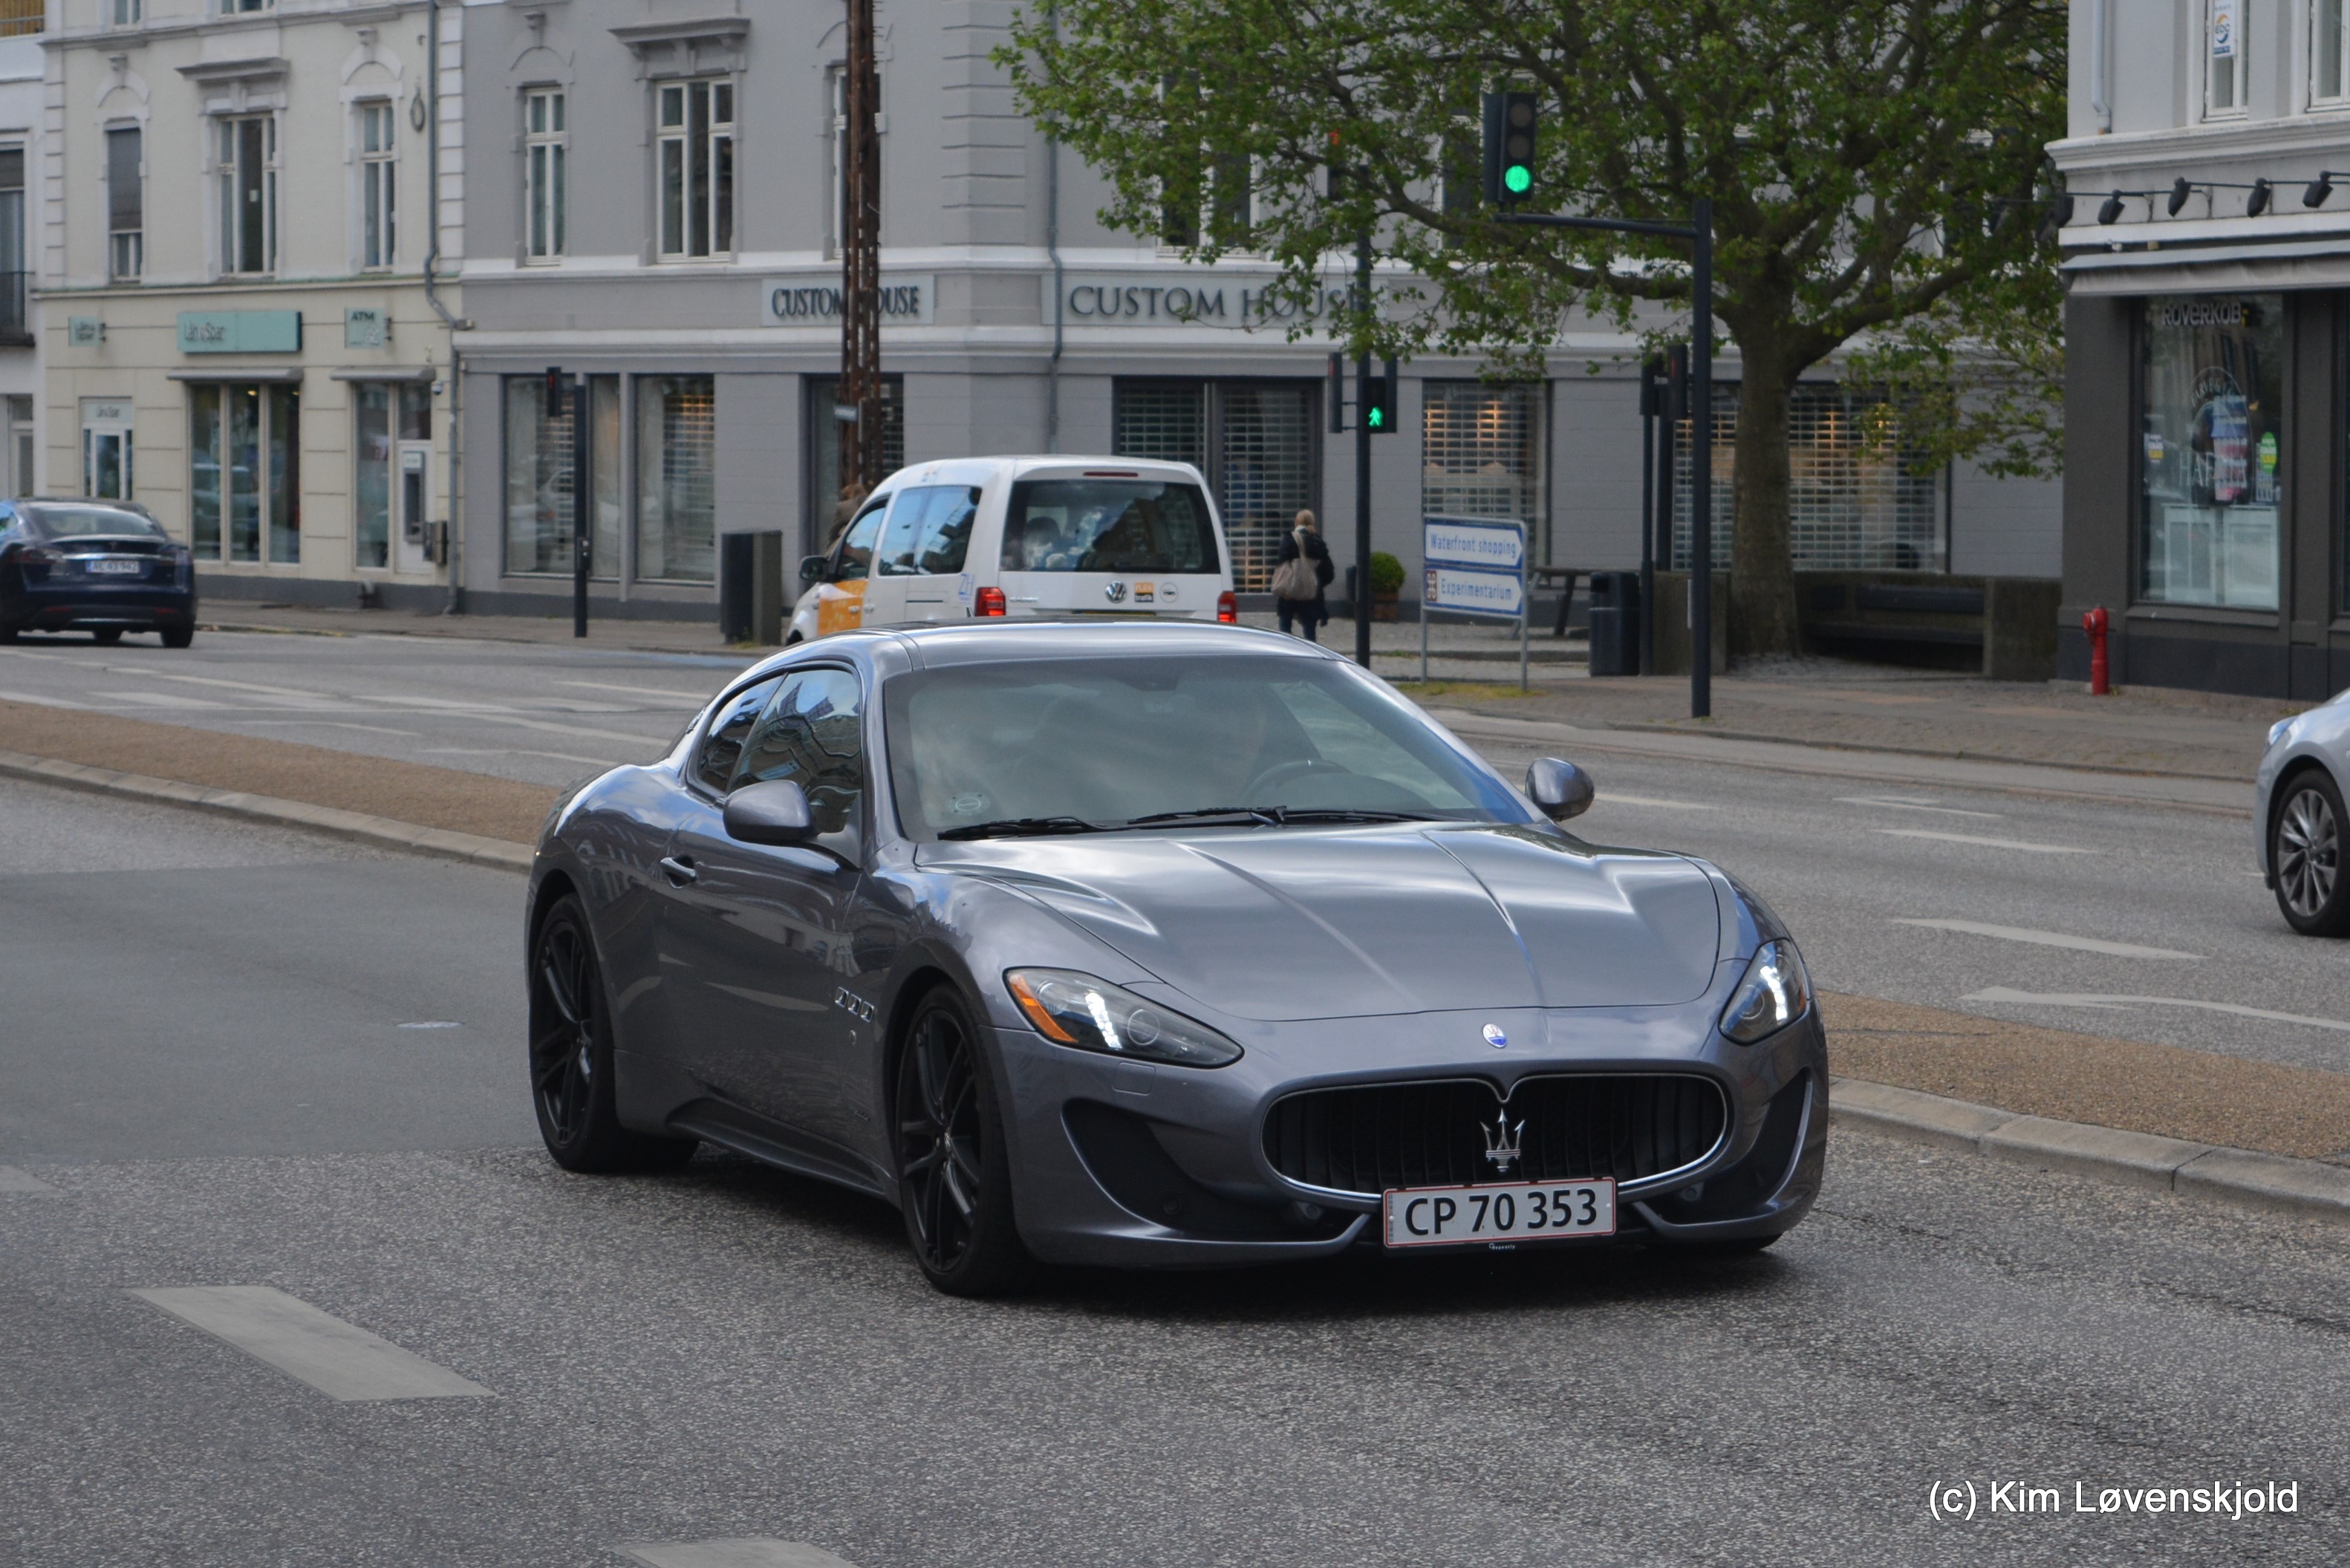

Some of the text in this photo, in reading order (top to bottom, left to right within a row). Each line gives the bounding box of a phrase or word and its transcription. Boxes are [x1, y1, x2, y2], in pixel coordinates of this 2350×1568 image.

[1070, 285, 1226, 316] CUSTOM
[350, 311, 374, 322] ATM
[1430, 533, 1516, 558] Waterfront shopping
[1441, 578, 1512, 600] Experimentarium
[1405, 1188, 1597, 1236] CP 70 353
